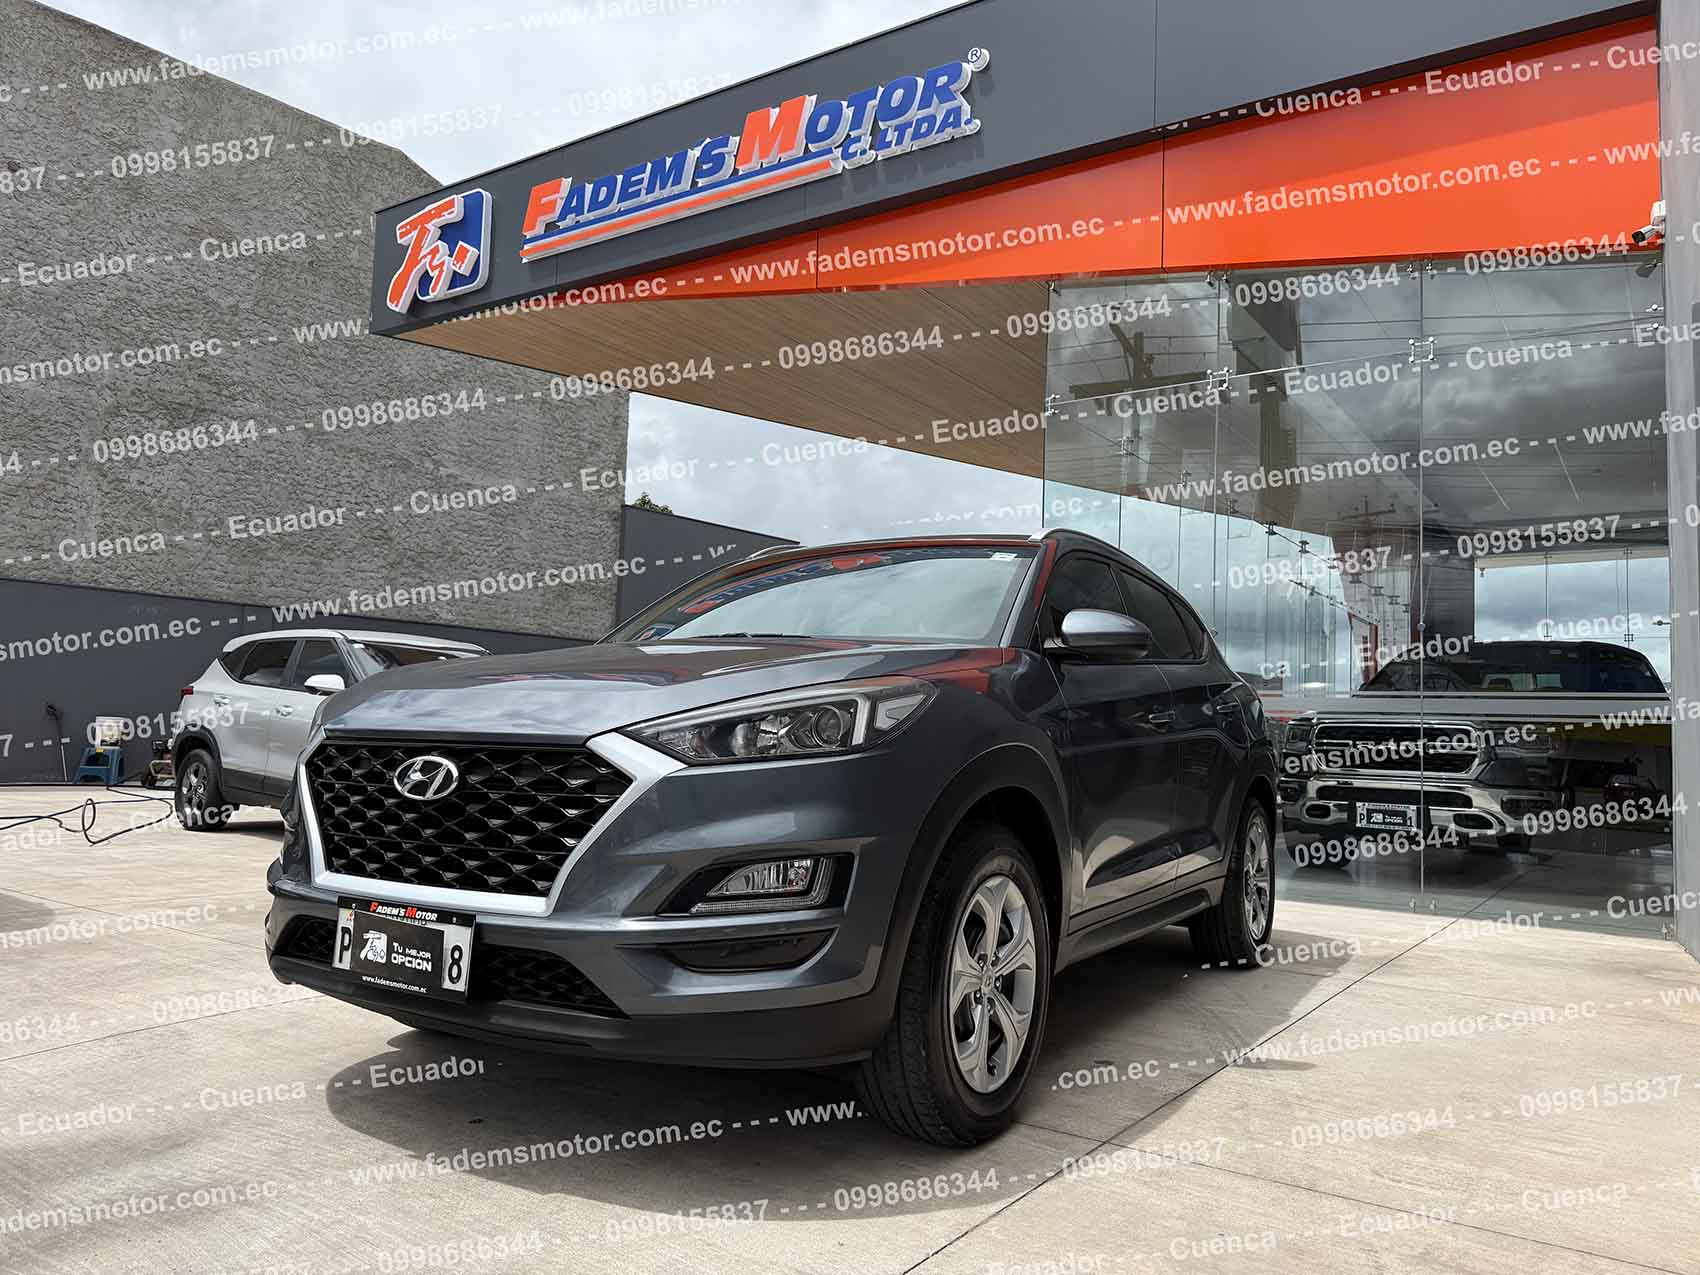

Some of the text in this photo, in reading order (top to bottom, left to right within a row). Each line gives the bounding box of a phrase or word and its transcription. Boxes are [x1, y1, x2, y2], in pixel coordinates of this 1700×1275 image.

[735, 60, 972, 171] MOTOR
[875, 105, 981, 160] LTDA.
[338, 926, 352, 964] P
[448, 944, 464, 985] 8
